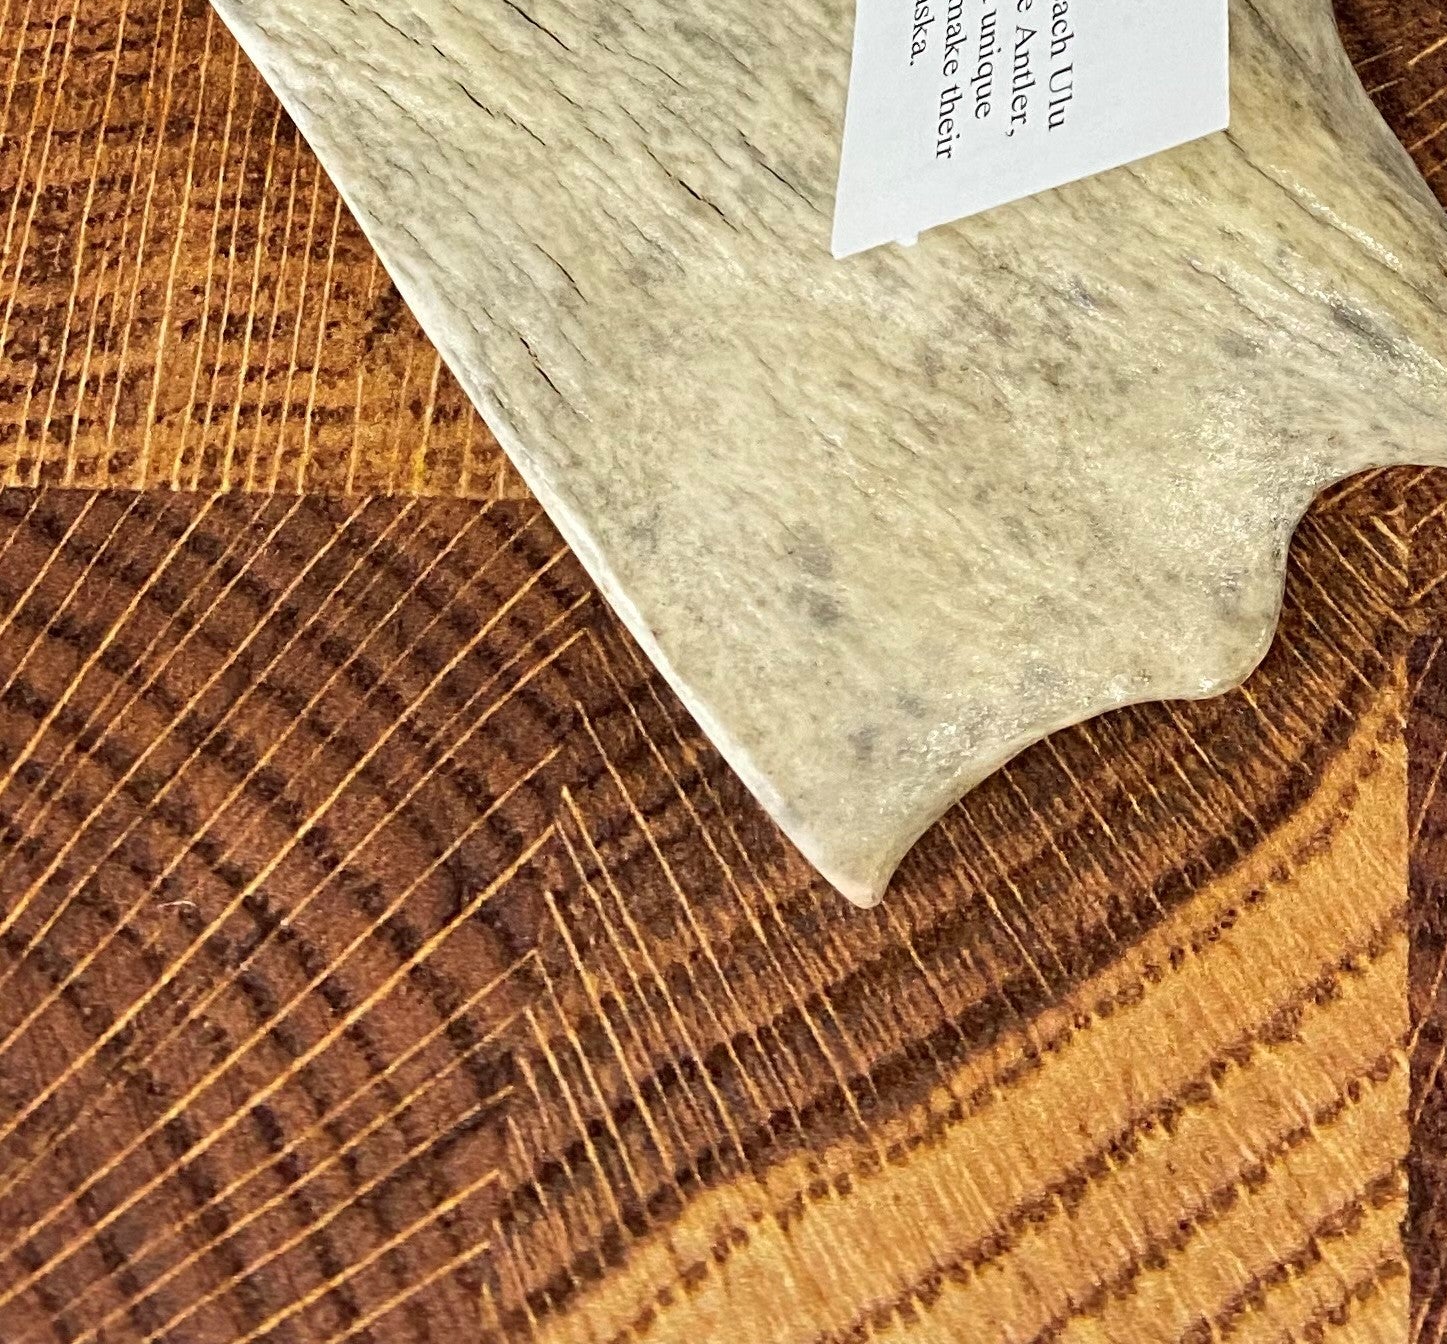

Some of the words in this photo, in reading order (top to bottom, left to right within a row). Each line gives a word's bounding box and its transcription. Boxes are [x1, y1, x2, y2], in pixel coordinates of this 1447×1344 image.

[969, 8, 998, 120] unique
[1004, 24, 1038, 138] Antler,
[1047, 61, 1074, 133] Ulu
[935, 82, 964, 160] their
